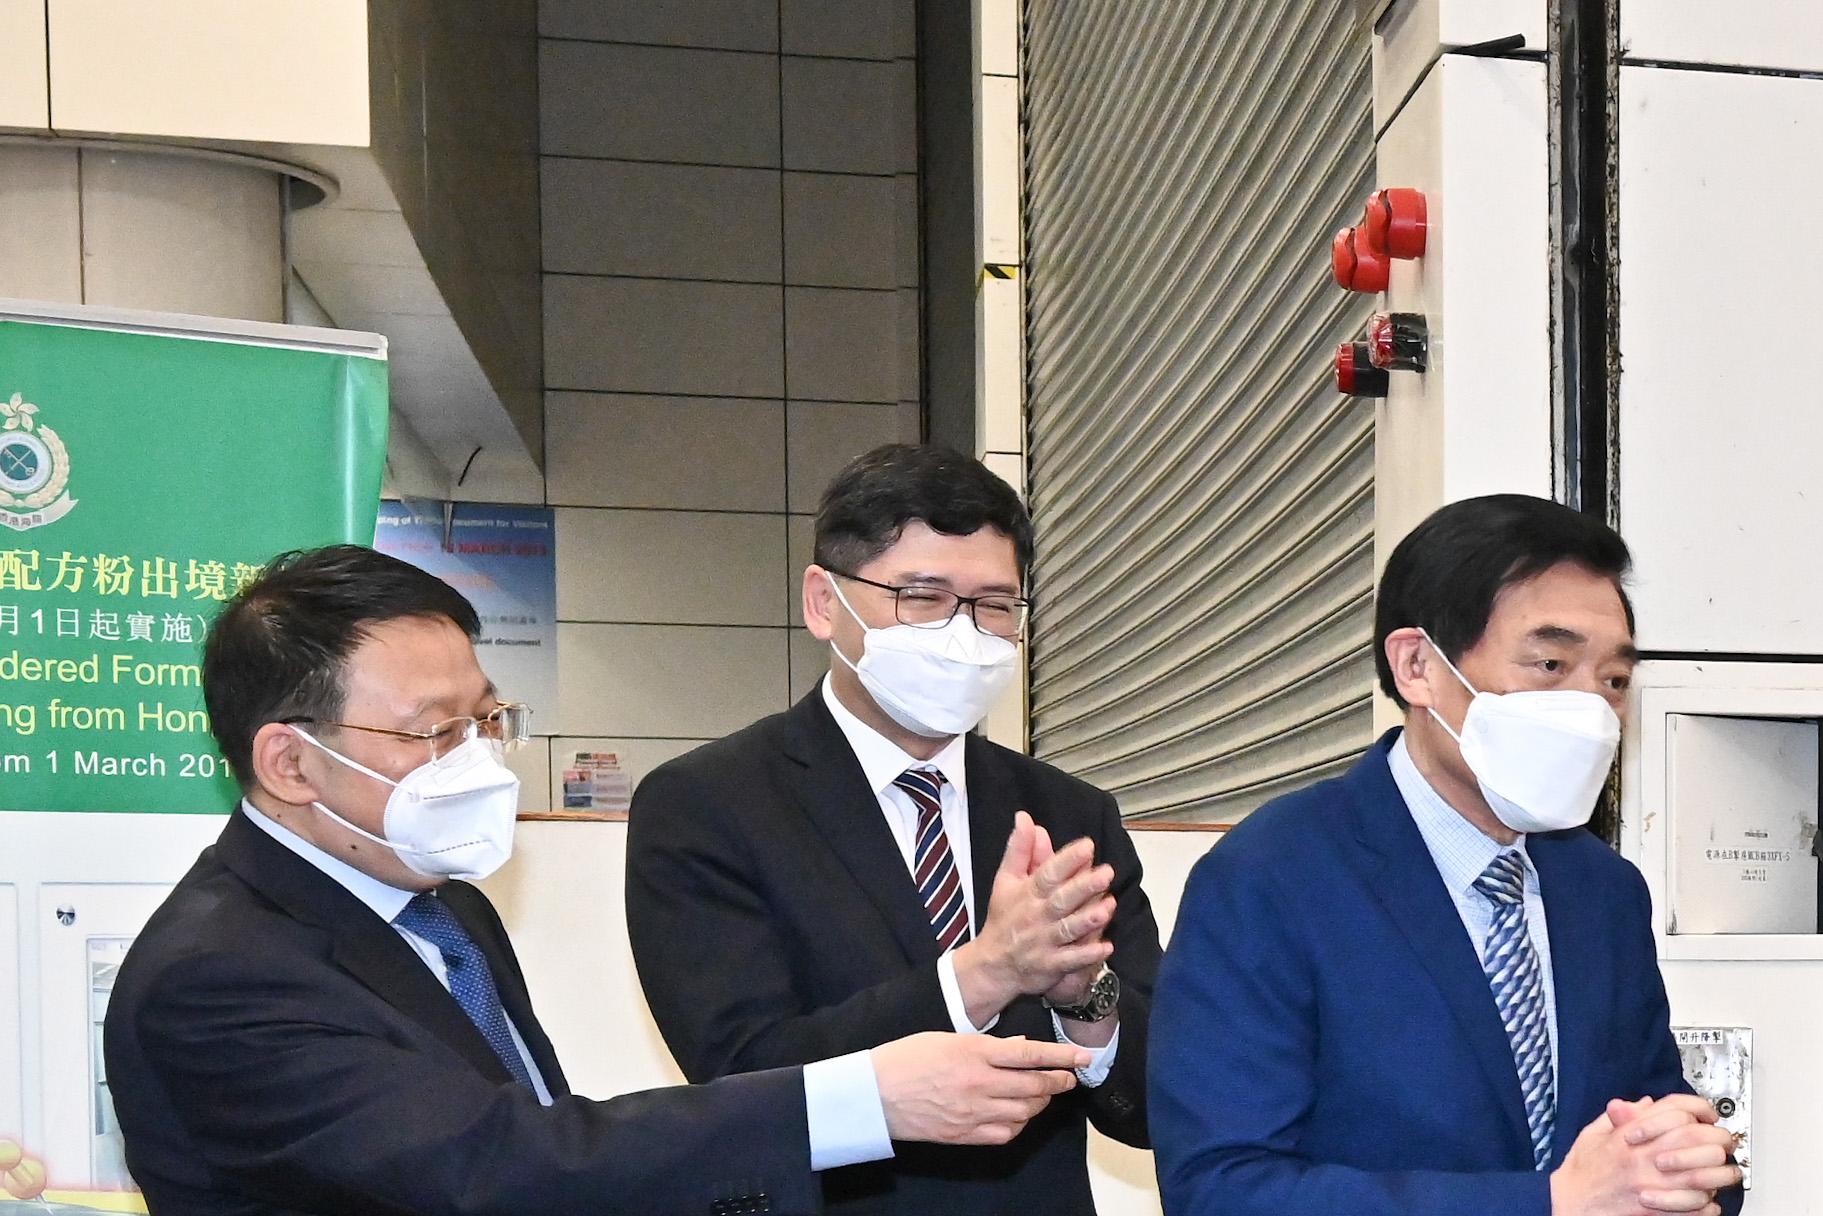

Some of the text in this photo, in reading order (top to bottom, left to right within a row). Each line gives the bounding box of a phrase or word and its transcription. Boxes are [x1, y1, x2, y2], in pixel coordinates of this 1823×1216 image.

[0, 650, 201, 687] dered Form
[48, 698, 125, 731] from
[138, 702, 214, 738] Hon
[46, 750, 58, 773] 1
[74, 751, 166, 777] March
